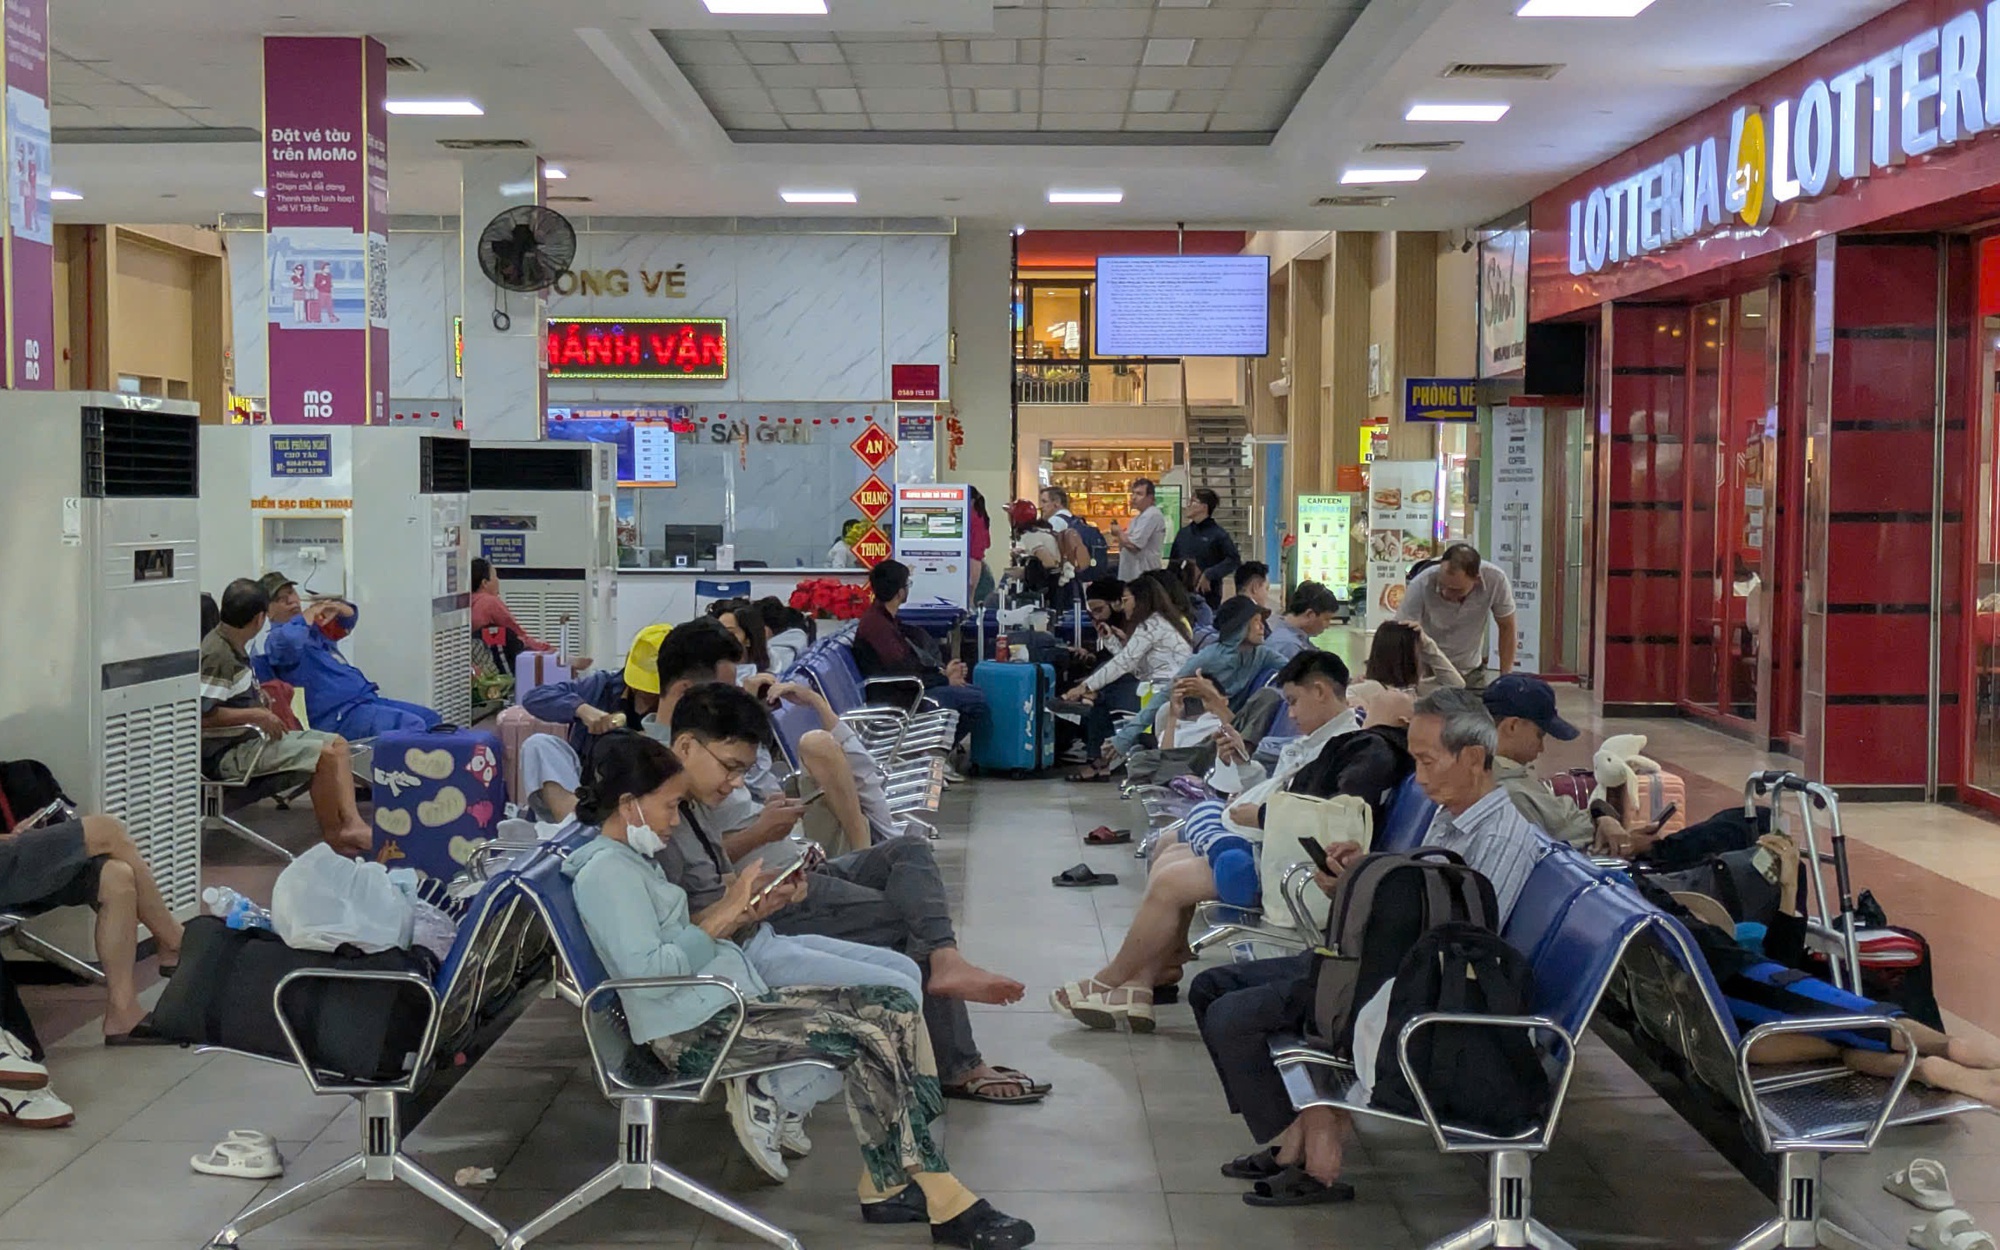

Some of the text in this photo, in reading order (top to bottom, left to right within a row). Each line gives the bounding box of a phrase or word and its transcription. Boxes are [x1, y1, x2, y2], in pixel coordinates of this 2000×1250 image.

[271, 128, 301, 146] Đặt
[303, 128, 322, 143] vé
[325, 128, 351, 143] tàu
[272, 146, 358, 162] trên MoMo
[1569, 136, 1722, 277] LOTTERIA
[639, 263, 687, 298] VÉ
[1412, 381, 1457, 406] PHÒNG
[865, 440, 883, 454] AN
[861, 491, 888, 505] KHANG
[860, 543, 887, 560] THỊNH
